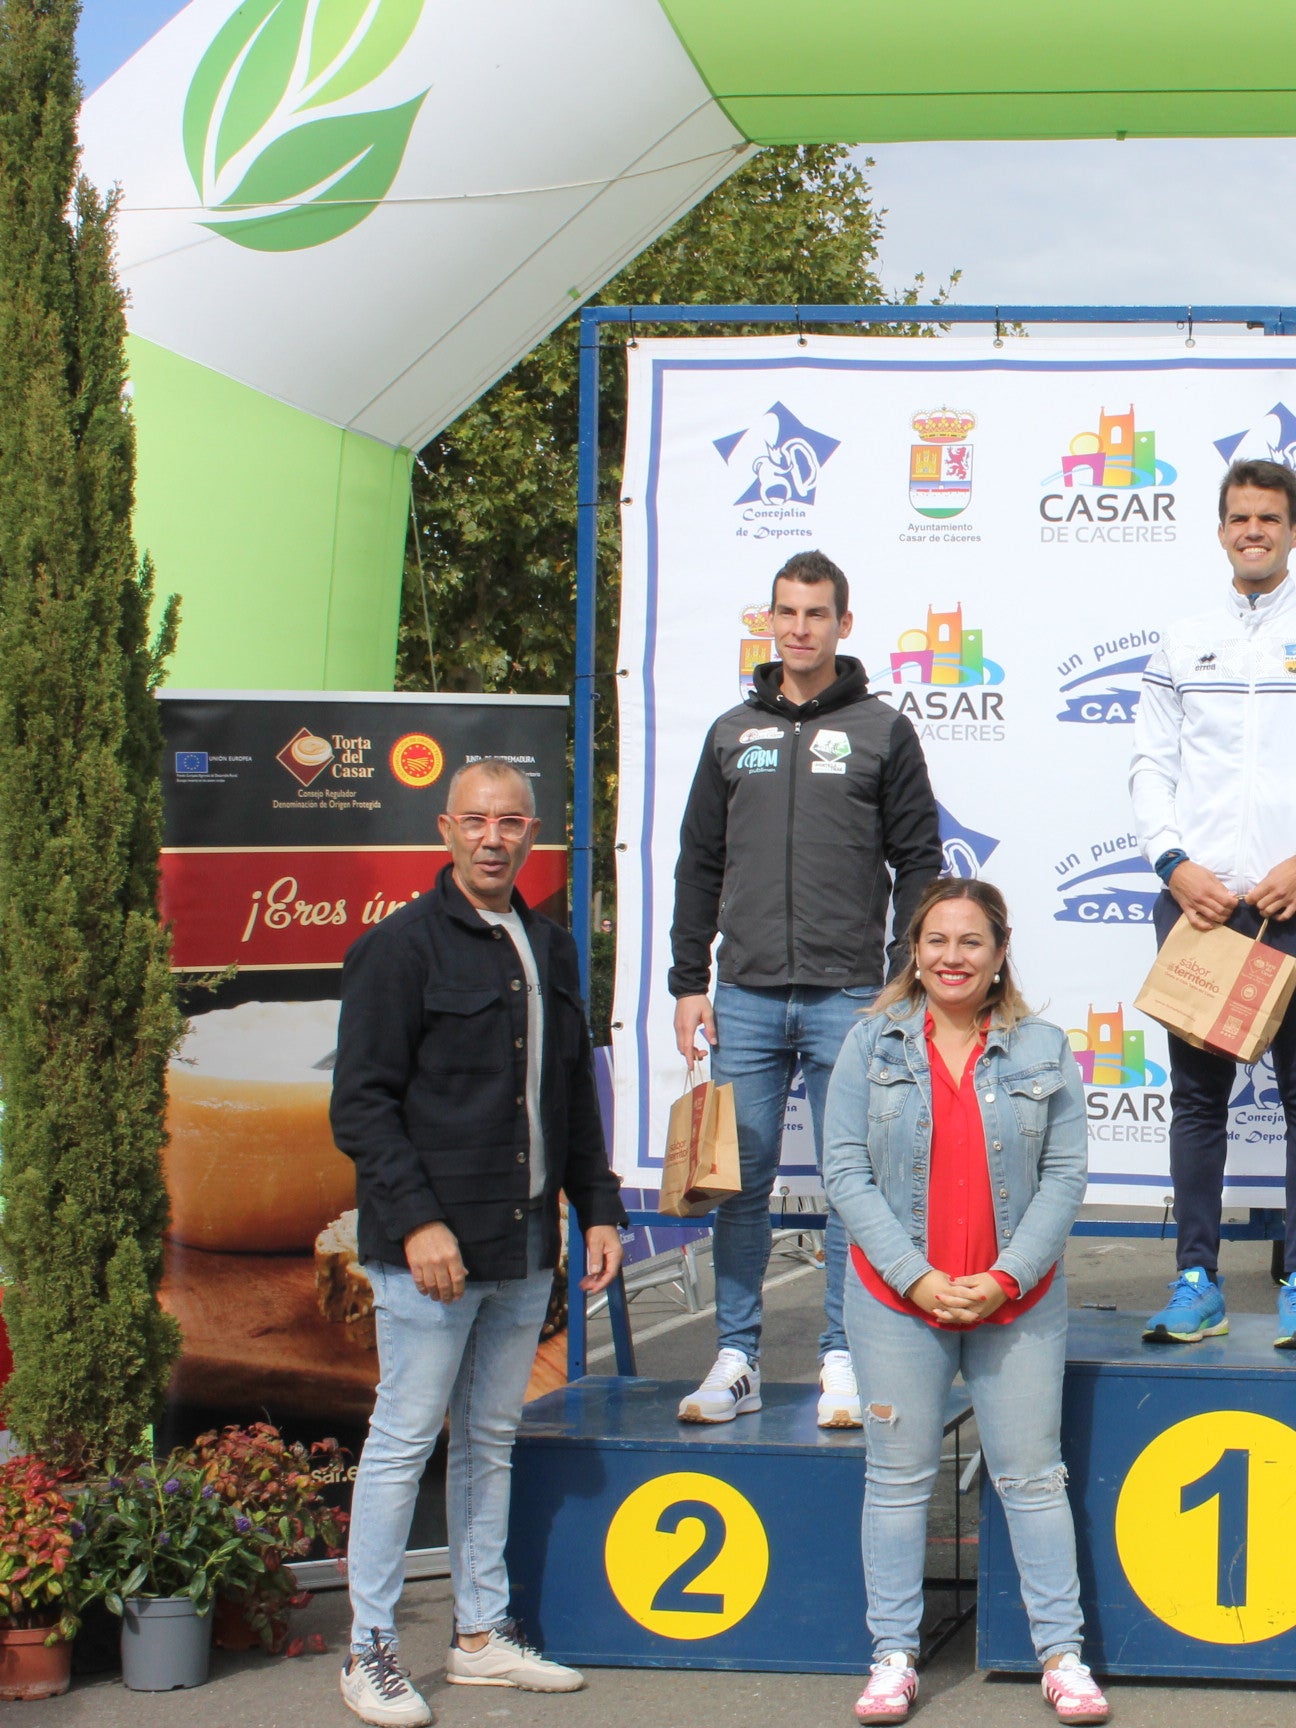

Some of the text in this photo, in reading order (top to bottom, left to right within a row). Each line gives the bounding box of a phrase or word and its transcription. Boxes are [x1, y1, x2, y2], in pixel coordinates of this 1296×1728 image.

[1039, 493, 1176, 522] CASAR
[735, 526, 813, 539] de Deportes
[908, 523, 973, 533] Ayuntamiento
[1040, 526, 1069, 543] DE
[899, 533, 981, 542] Casar de Cáceres
[1057, 630, 1160, 676] un pueblo
[914, 724, 1006, 741] ÁCERES
[332, 734, 371, 750] Torta
[341, 750, 364, 764] del
[331, 765, 375, 779] Casar
[298, 789, 357, 799] Consejo Regulador
[272, 800, 381, 810] Denominación de Origen Protegida
[1054, 833, 1138, 875] un pueb
[241, 876, 348, 942] ¡Eres
[1078, 901, 1152, 920] CAS
[1179, 957, 1211, 977] sabor
[1173, 966, 1220, 994] territorio
[1086, 1092, 1166, 1122] SAR
[1235, 1112, 1285, 1125] Conceja
[1087, 1124, 1167, 1143] ÁCERES
[1227, 1131, 1240, 1141] de
[1179, 1447, 1251, 1608] 1
[650, 1499, 727, 1614] 2
